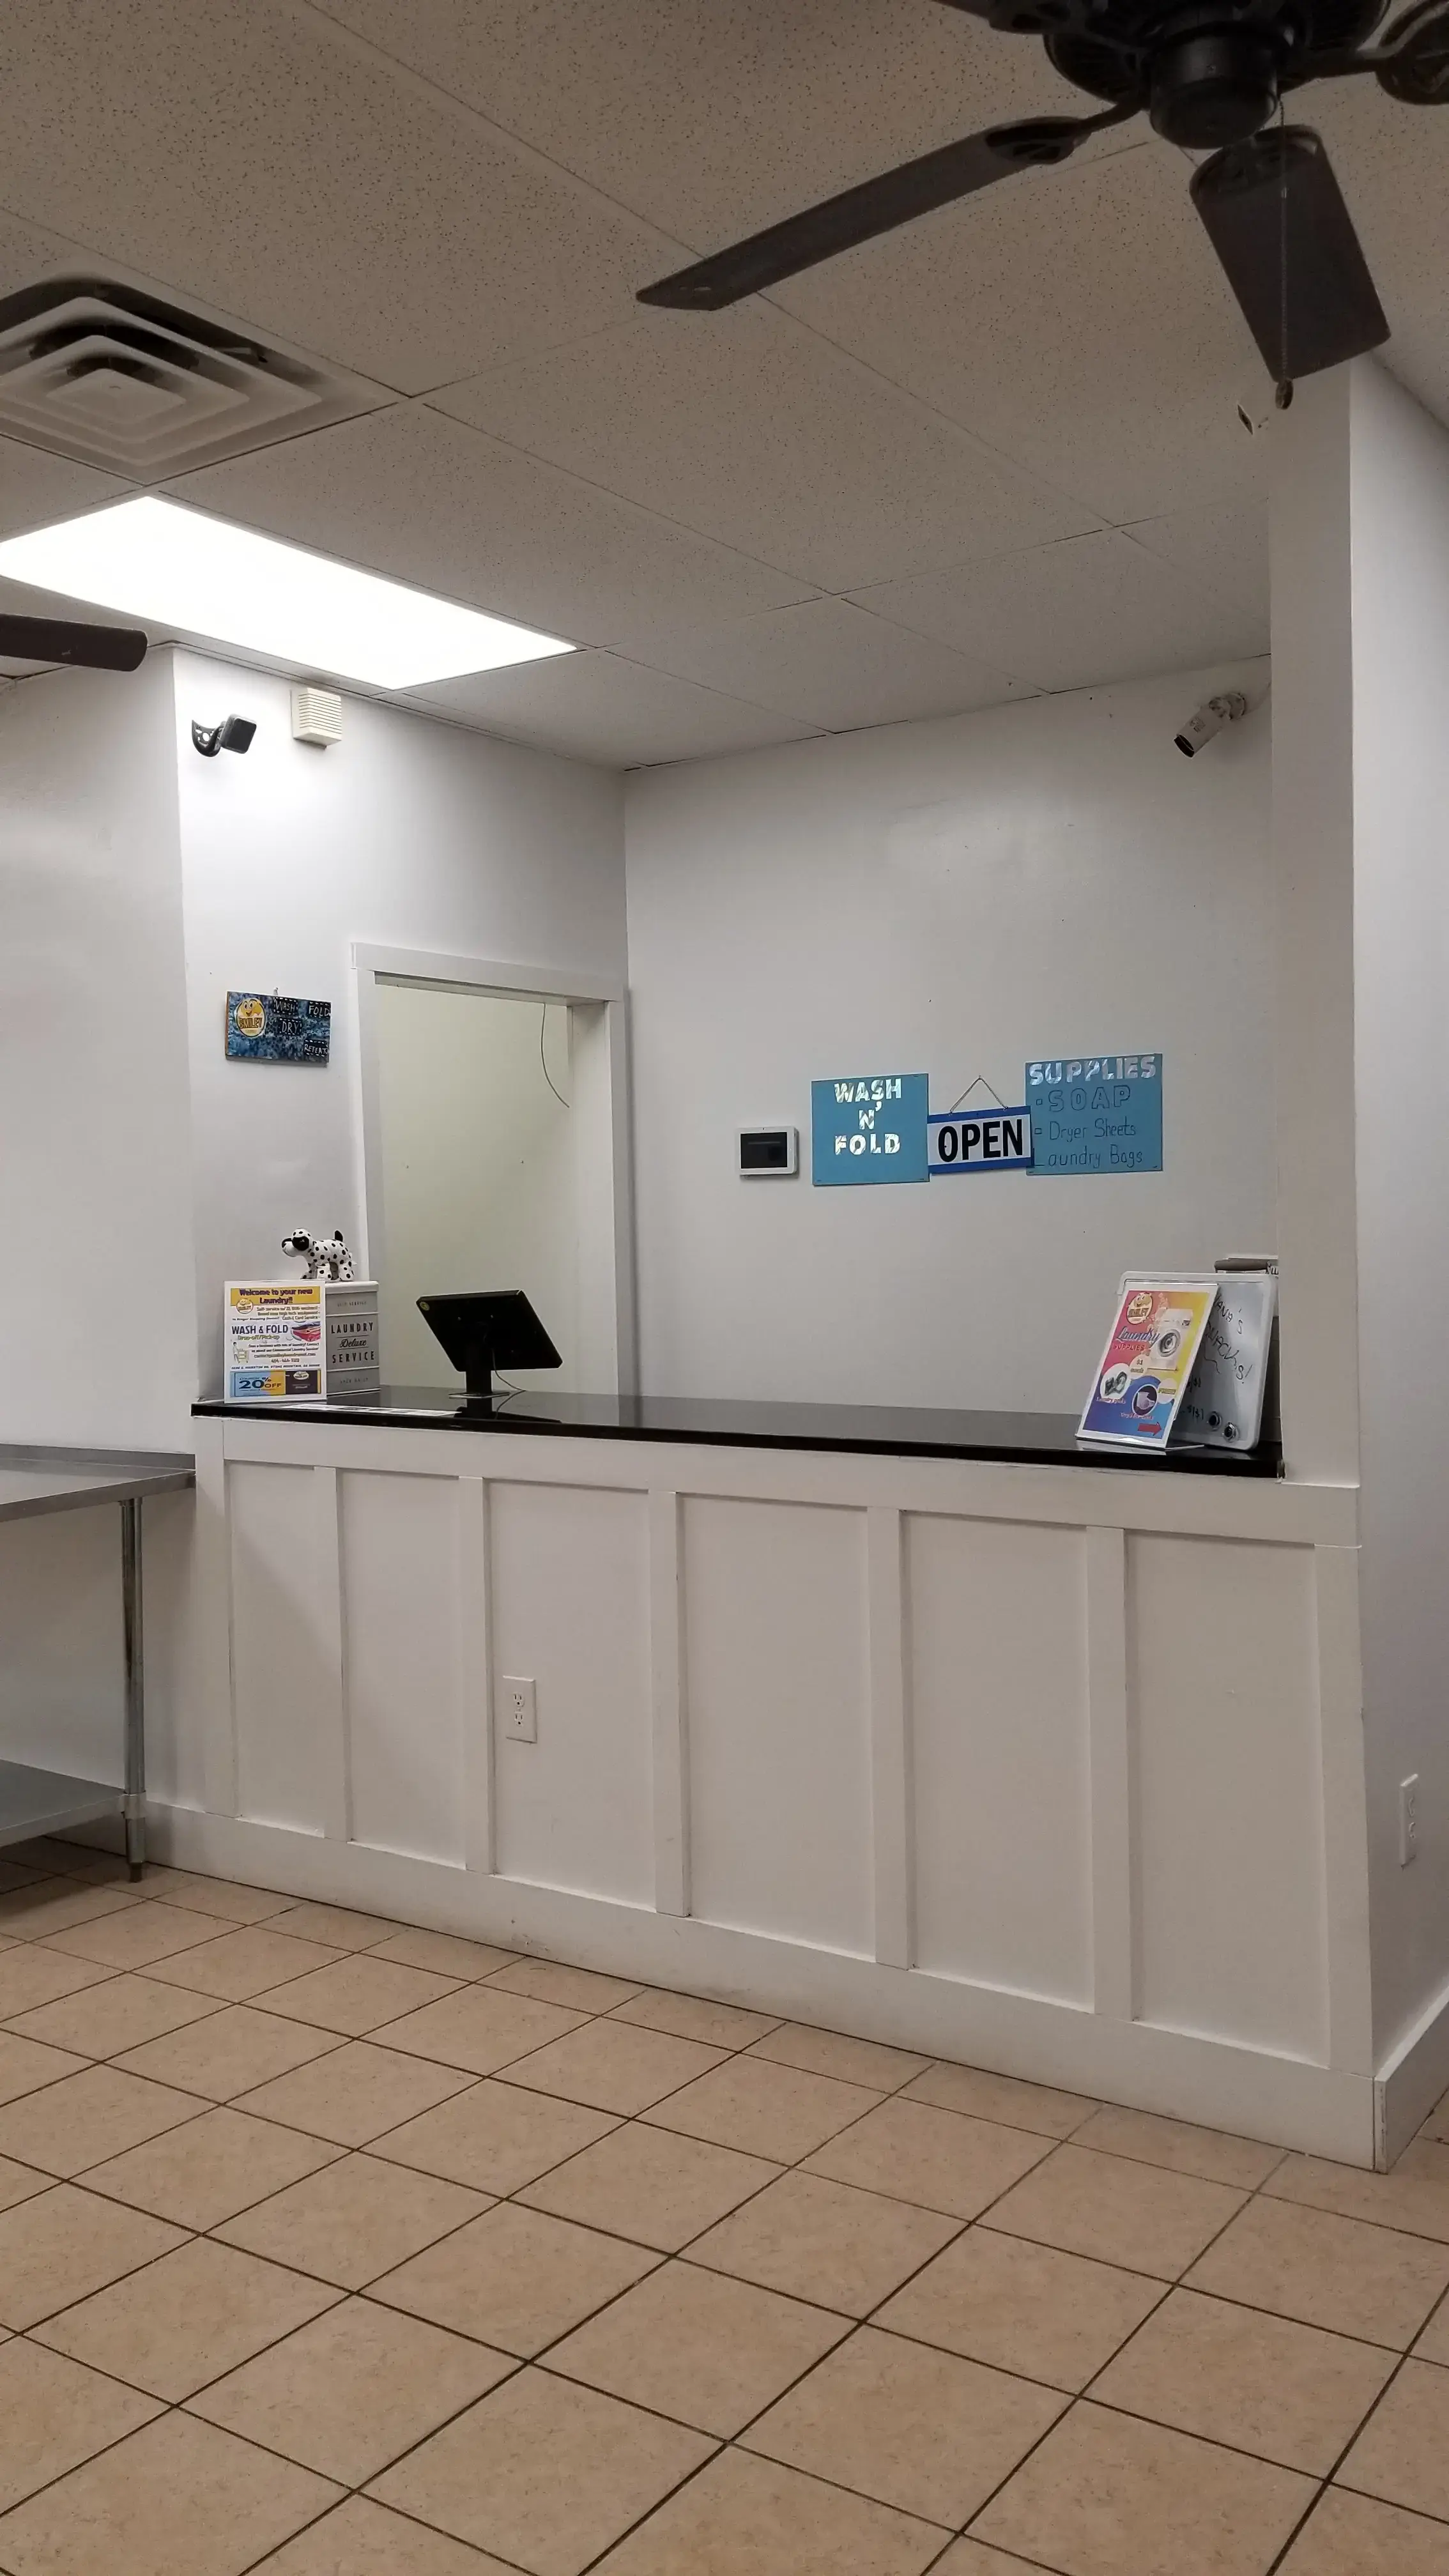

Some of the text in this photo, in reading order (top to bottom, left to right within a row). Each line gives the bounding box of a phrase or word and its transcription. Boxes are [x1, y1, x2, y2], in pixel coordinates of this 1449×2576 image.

[275, 1000, 330, 1016] WASH FOLD
[239, 1017, 263, 1029] SMILEY
[282, 1022, 298, 1033] DRY
[1029, 1056, 1156, 1085] SUPPLIES
[834, 1078, 901, 1103] WASH
[1048, 1085, 1130, 1112] SOAP
[1049, 1116, 1137, 1142] Dryer Sheets
[835, 1133, 900, 1155] FOLD
[938, 1119, 1023, 1162] OPEN
[1110, 1144, 1142, 1168] Bags
[231, 1324, 288, 1335] WASH & FOLD
[331, 1322, 373, 1334] LAUNDRY
[1117, 1326, 1161, 1348] Laundry
[339, 1338, 367, 1347] Deluxe
[332, 1351, 374, 1363] SERVICE
[238, 1380, 264, 1390] 20
